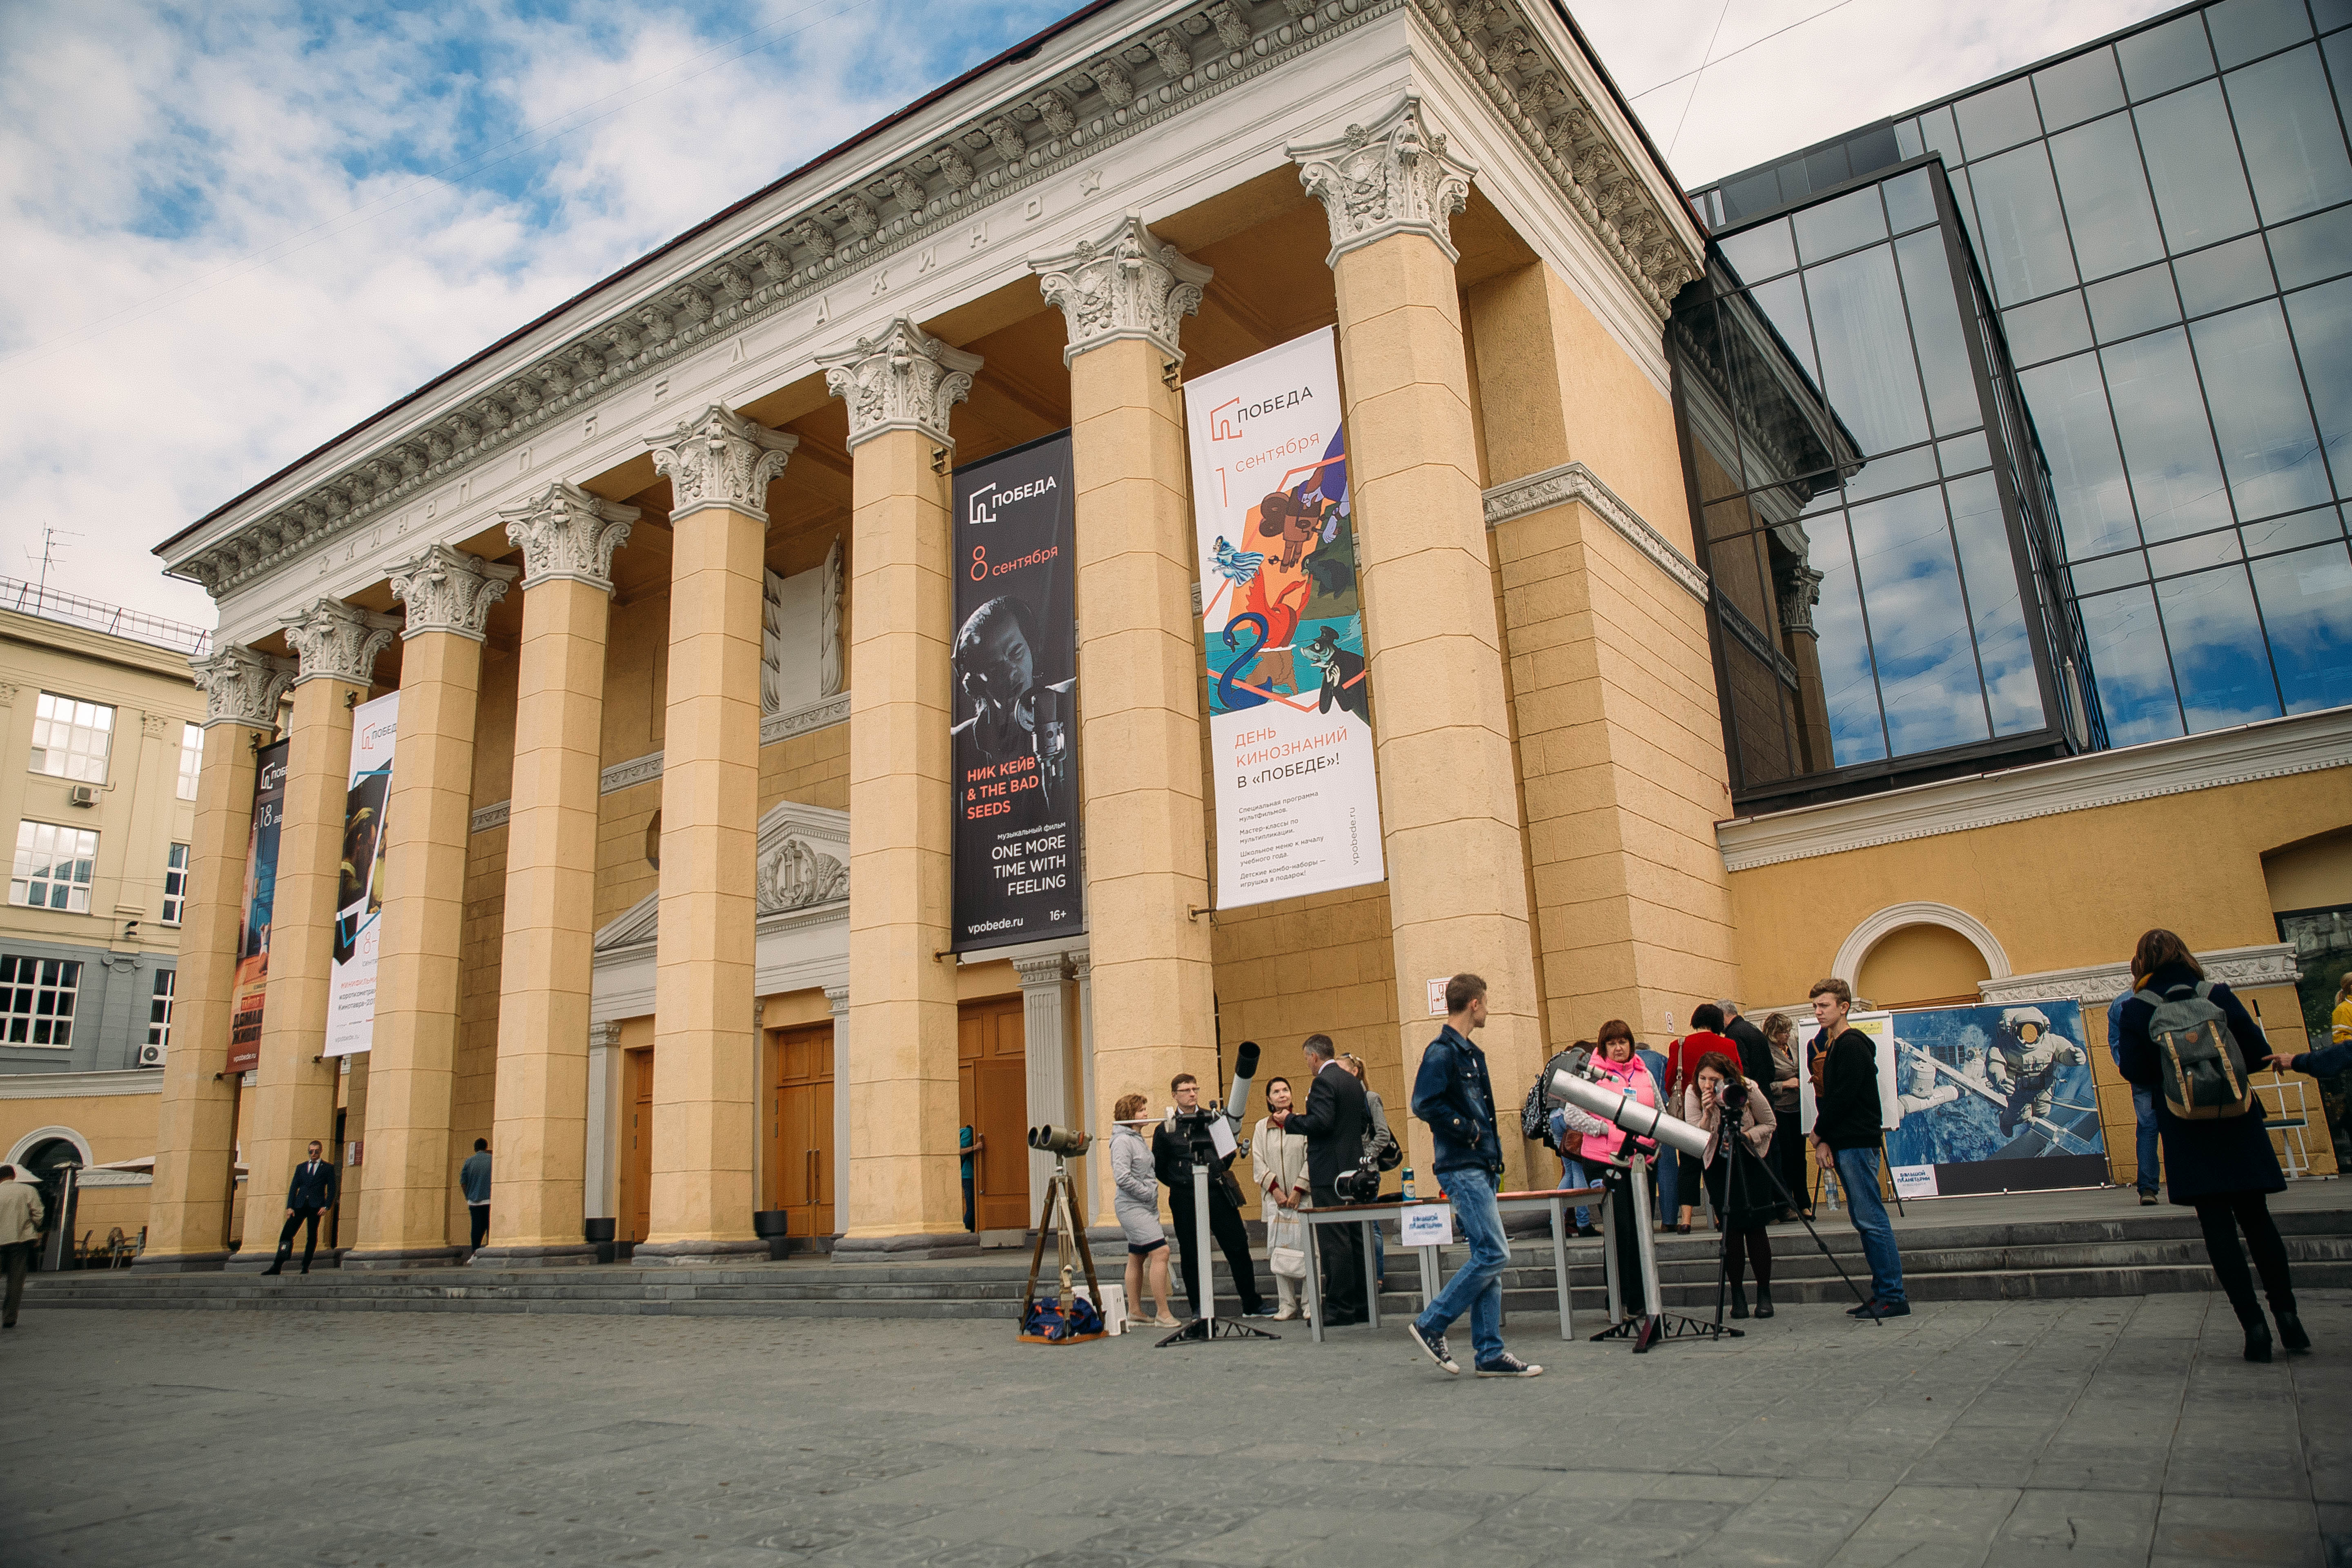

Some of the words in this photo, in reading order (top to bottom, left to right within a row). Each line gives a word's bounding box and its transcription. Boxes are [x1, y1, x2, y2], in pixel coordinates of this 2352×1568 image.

[1238, 387, 1313, 423] ПОБЕДА
[1216, 467, 1227, 508] 1
[1236, 433, 1319, 472] сентября
[993, 476, 1057, 508] ПОБЕДА
[971, 546, 988, 581] 8
[992, 546, 1058, 576] сентября
[1235, 727, 1276, 749] ДЕНЬ
[1236, 726, 1347, 767] КИНОЗНАНИЙ
[967, 764, 996, 782] НИК
[1000, 756, 1035, 775] КЕЙВ
[1238, 776, 1247, 788] В
[1252, 753, 1339, 784] «ПОБЕДЕ»!
[967, 788, 976, 801] &
[980, 782, 1007, 799] THE
[1010, 775, 1038, 793] BAD
[967, 800, 1011, 820] SEEDS
[1239, 800, 1281, 813] Специальная
[1283, 792, 1319, 804] программа
[260, 804, 272, 828] 18
[1239, 808, 1288, 822] мультфильмов.
[997, 825, 1042, 840] музыкальный
[1044, 822, 1066, 832] фильм
[1240, 821, 1289, 835] Мастер-классы
[1240, 829, 1295, 844] мультипликации.
[1350, 807, 1359, 865] vpobede.ru
[991, 843, 1022, 860] ONE
[1026, 835, 1066, 855] MORE
[1240, 846, 1274, 858] Школьное
[1301, 836, 1324, 844] началу
[993, 862, 1025, 878] TIME
[1029, 854, 1066, 873] WITH
[1240, 856, 1271, 867] учебного
[1240, 870, 1267, 880] Детские
[1269, 860, 1318, 874] комбо-наборы
[1008, 874, 1066, 896] FEELING
[1240, 878, 1268, 888] игрушка
[1275, 870, 1306, 881] подарок!
[968, 918, 1023, 935] vpobede.ru
[1049, 910, 1067, 921] 16+
[339, 989, 376, 1000] короткометра
